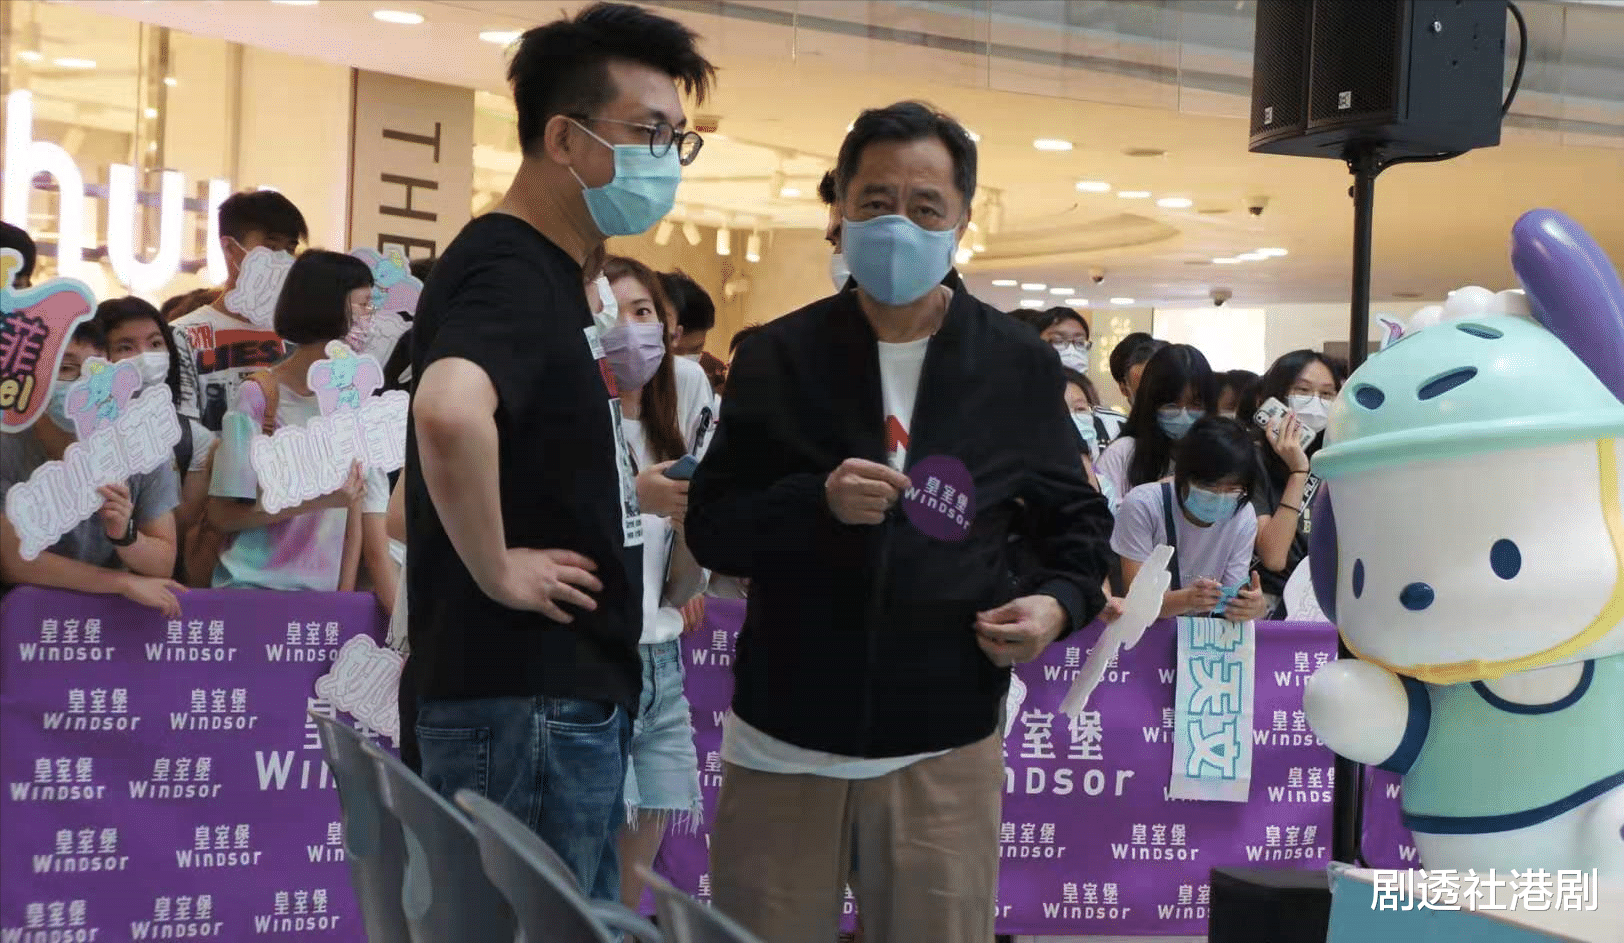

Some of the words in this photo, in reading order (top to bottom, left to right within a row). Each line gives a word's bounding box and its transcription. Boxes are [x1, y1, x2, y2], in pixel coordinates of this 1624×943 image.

[4, 89, 281, 291] hu
[924, 476, 968, 514] 皇室堡
[40, 618, 101, 644] 皇室堡
[166, 620, 225, 645] 皇室堡
[286, 621, 339, 646] 皇室堡
[68, 688, 128, 714] 皇室堡
[191, 688, 247, 714] 皇室堡
[1003, 708, 1104, 760] 室堡
[34, 757, 93, 783] 皇室堡
[152, 757, 212, 782] 皇室堡
[55, 827, 118, 854] 皇室堡
[194, 824, 250, 850] 皇室堡
[1132, 823, 1186, 846] 皇室堡
[1265, 825, 1318, 847] 皇室堡
[274, 889, 328, 915] 皇室堡
[1062, 882, 1118, 904] 皇室堡
[24, 900, 87, 928] 皇室堡
[153, 894, 212, 922] 皇室堡
